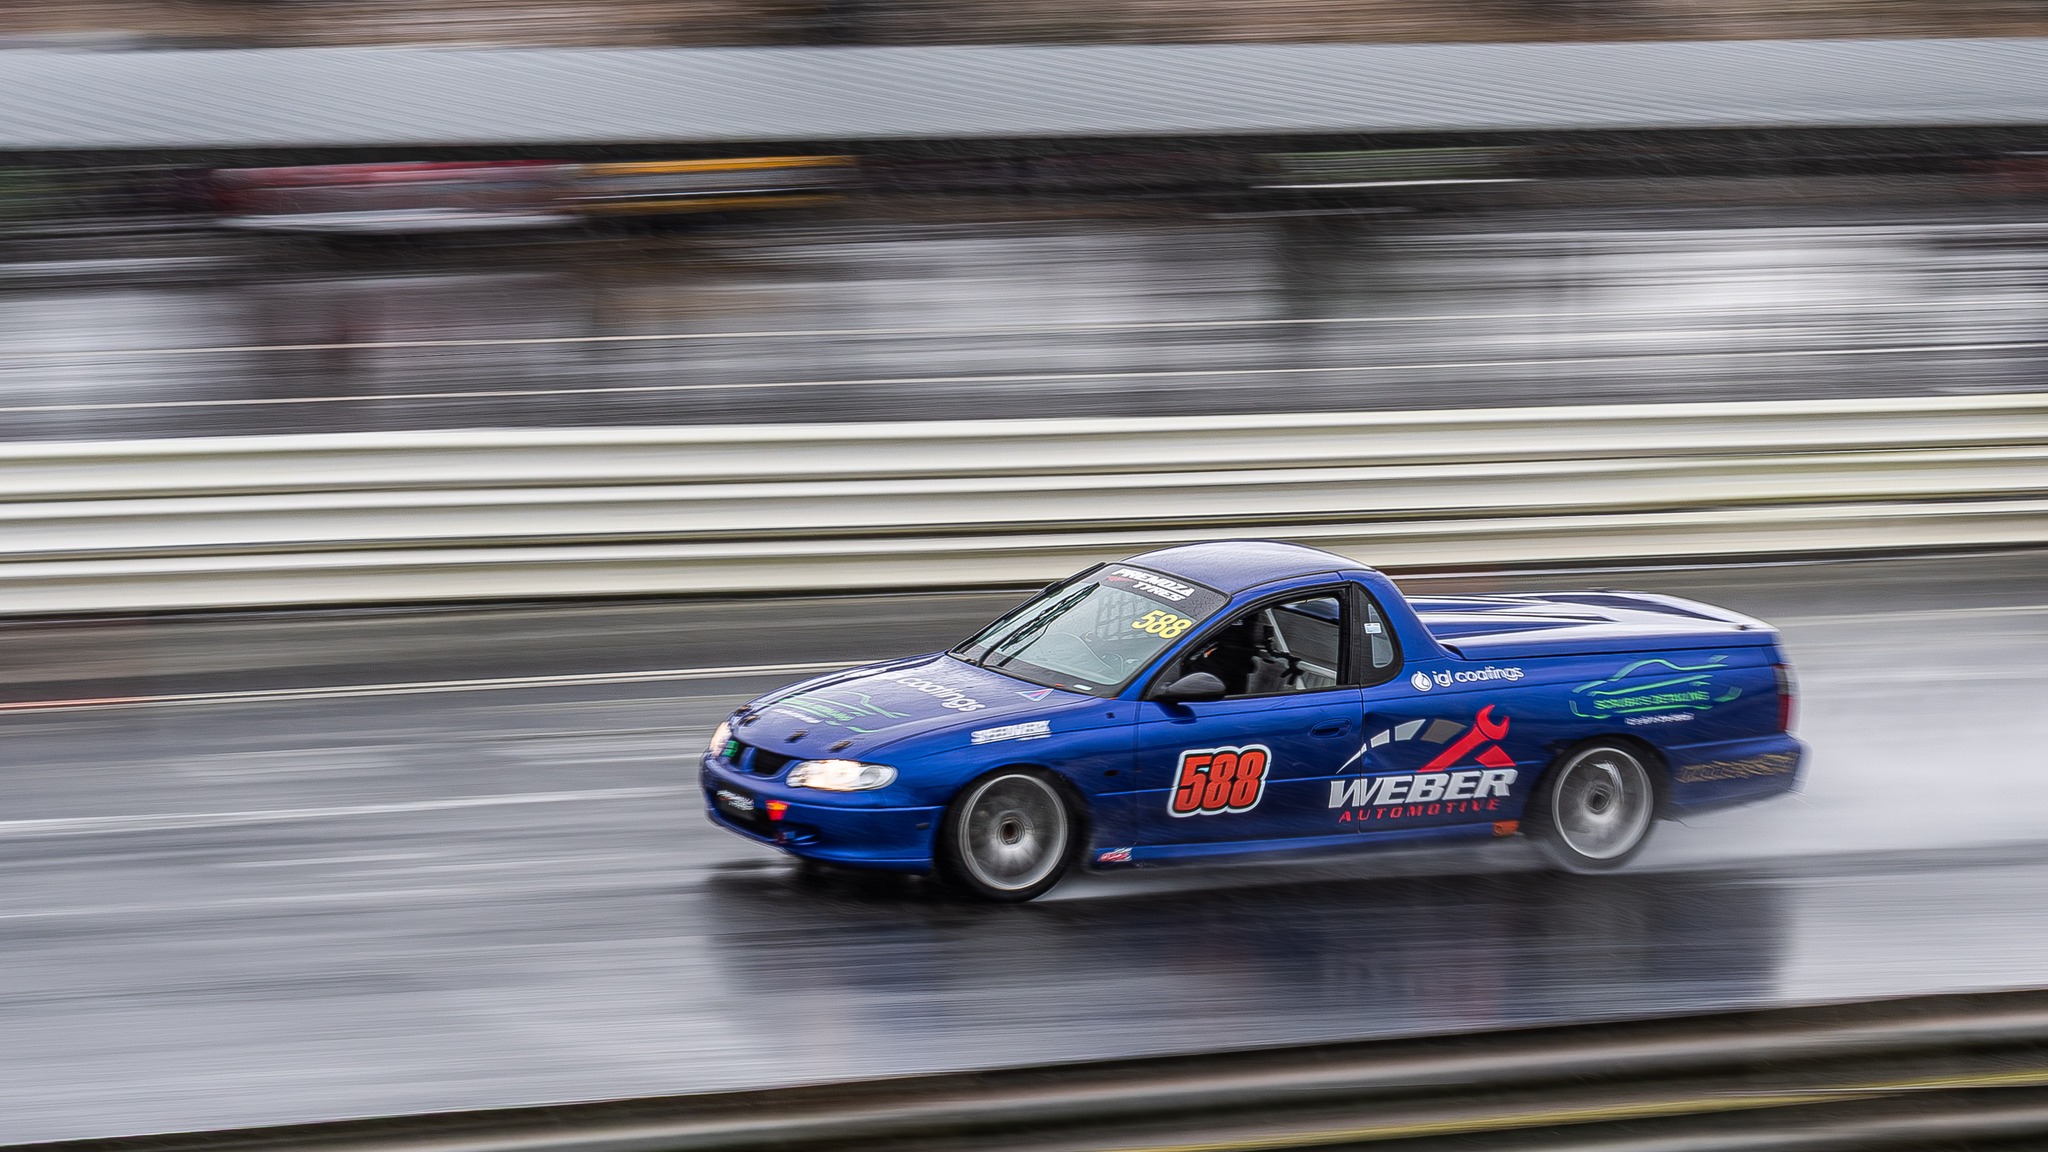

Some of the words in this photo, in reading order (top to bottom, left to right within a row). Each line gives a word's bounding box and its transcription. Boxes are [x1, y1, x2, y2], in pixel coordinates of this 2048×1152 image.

[1132, 581, 1186, 602] TYRES
[1131, 609, 1193, 639] 588
[1432, 669, 1454, 687] igl
[1455, 666, 1525, 682] coatings
[897, 677, 986, 711] coatings
[1169, 747, 1270, 815] 588
[1328, 769, 1518, 809] WEBER
[1338, 799, 1500, 824] AUTOMOTIVE
